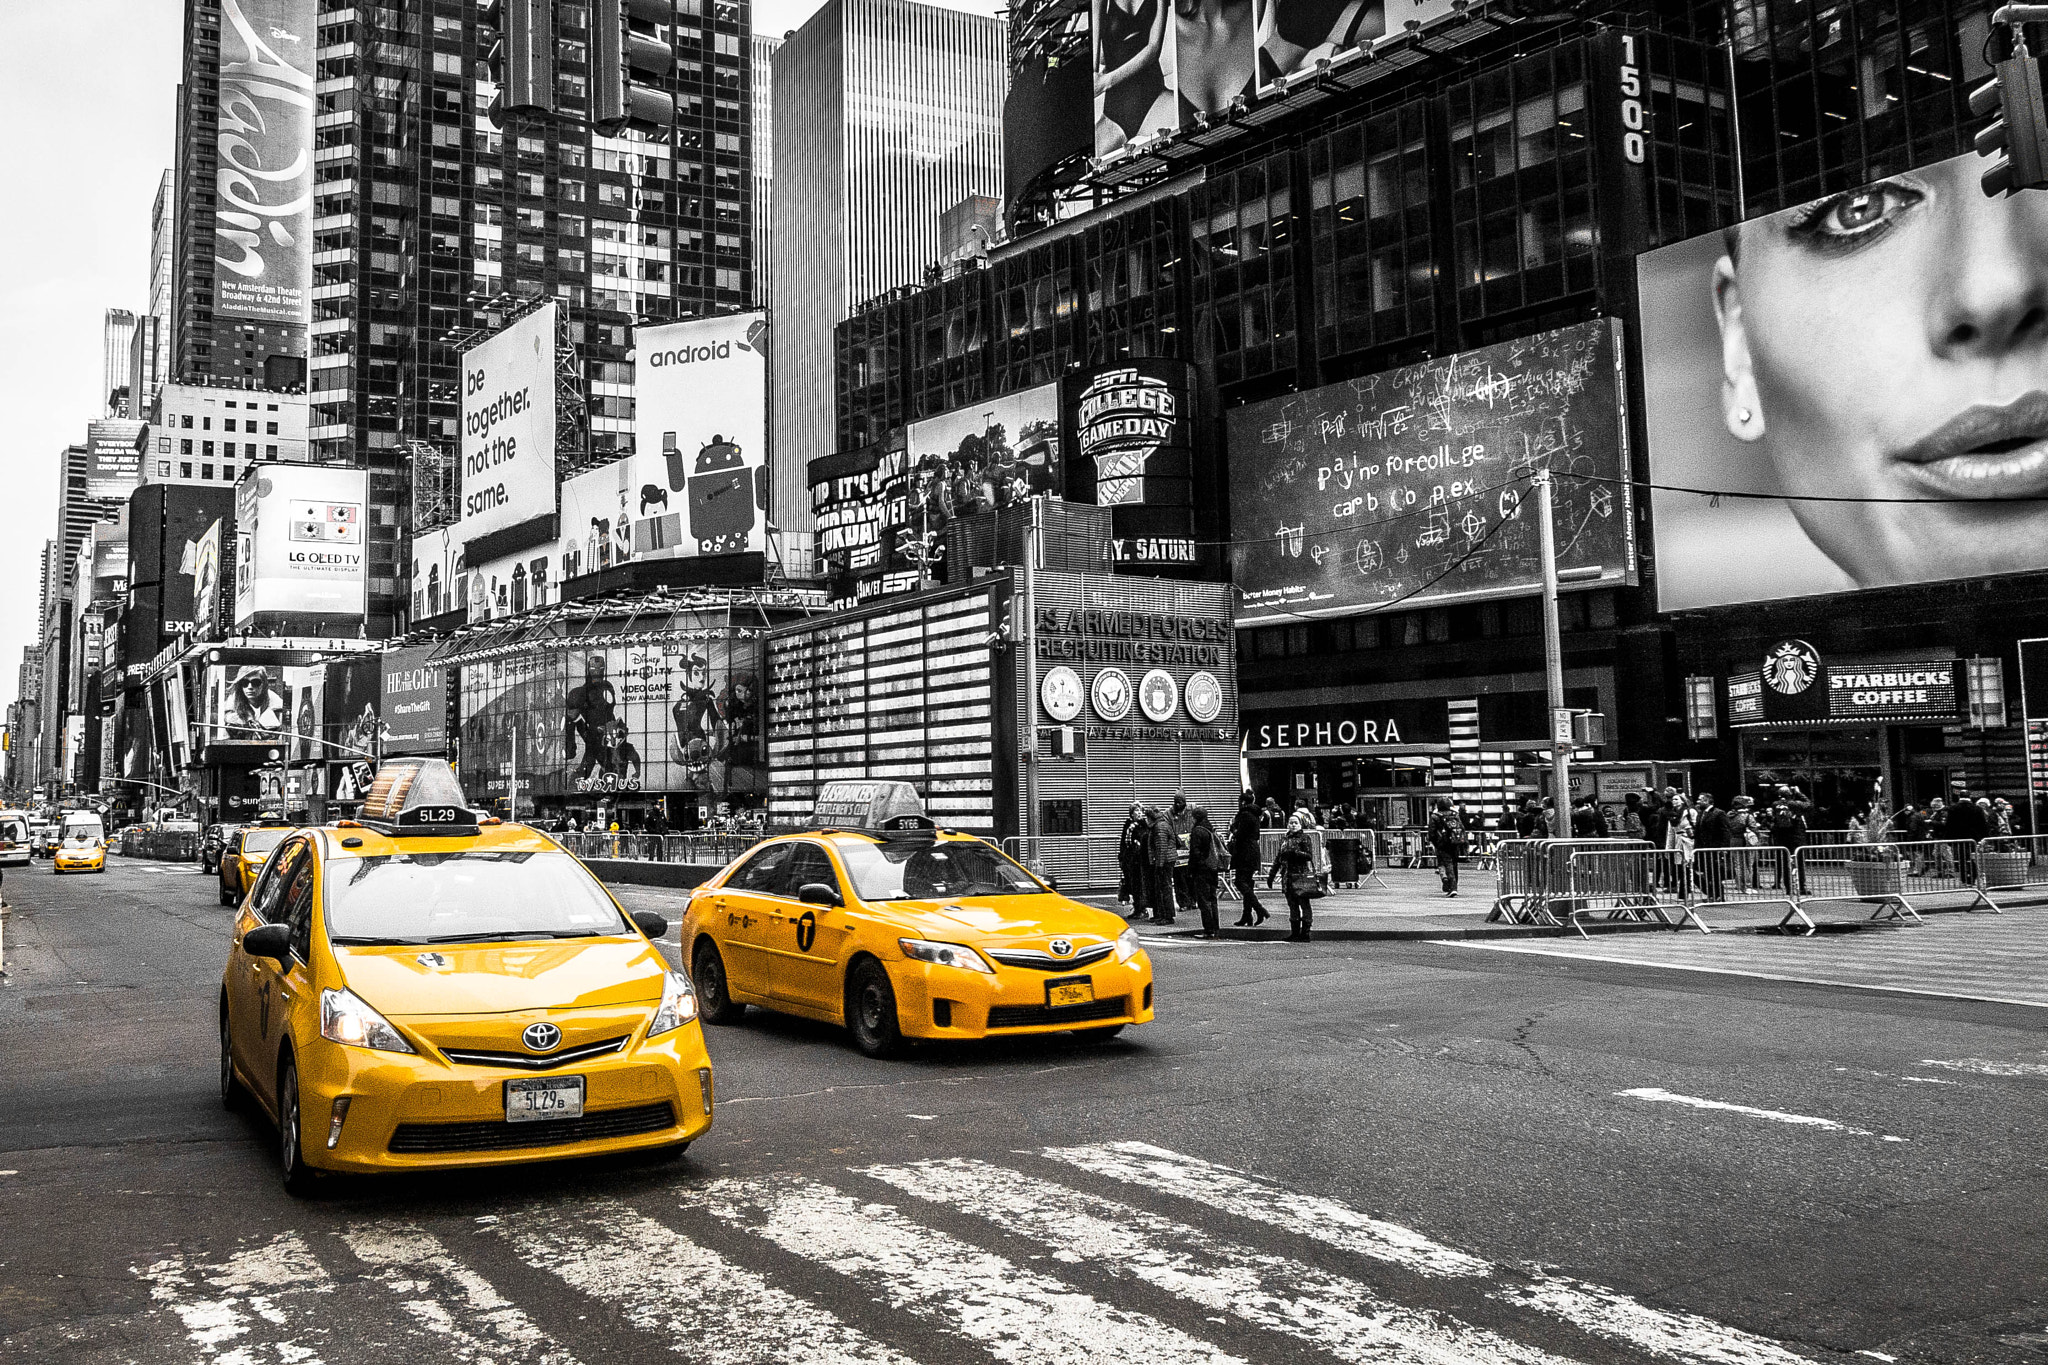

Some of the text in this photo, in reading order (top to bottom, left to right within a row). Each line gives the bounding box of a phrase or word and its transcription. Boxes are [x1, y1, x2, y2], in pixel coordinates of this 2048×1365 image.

[1621, 35, 1645, 164] 1500
[221, 280, 303, 297] New Amsterdam Theatre
[221, 290, 303, 306] Broadway & 42nd Street
[221, 303, 303, 317] AladdinTheMusical.com
[650, 339, 730, 368] android
[467, 368, 485, 397] be
[1093, 367, 1138, 390] ESPN
[467, 386, 531, 439] together.
[1080, 387, 1173, 429] COLLEGE
[1081, 417, 1170, 450] GAMEDAY
[467, 435, 517, 478] not the
[838, 473, 869, 500] IT'S
[467, 482, 509, 517] same.
[1626, 510, 1634, 542] Money
[289, 552, 360, 565] LG OLED TV
[1262, 588, 1283, 598] Money
[1067, 608, 1149, 635] ARMED
[1150, 613, 1230, 641] FORCES
[1036, 638, 1223, 664] RECRUITING STATION
[387, 671, 402, 693] HE
[412, 667, 438, 691] GIFT
[620, 683, 673, 694] VIDEO GAME
[1830, 671, 1951, 689] STARBUCKS
[394, 700, 431, 714] #ShareTheGift
[638, 693, 671, 701] AVAILABLE
[1852, 689, 1928, 705] COFFEE
[1183, 728, 1225, 740] MARINES
[1260, 718, 1402, 748] SEPHORA
[420, 809, 455, 822] 5L29
